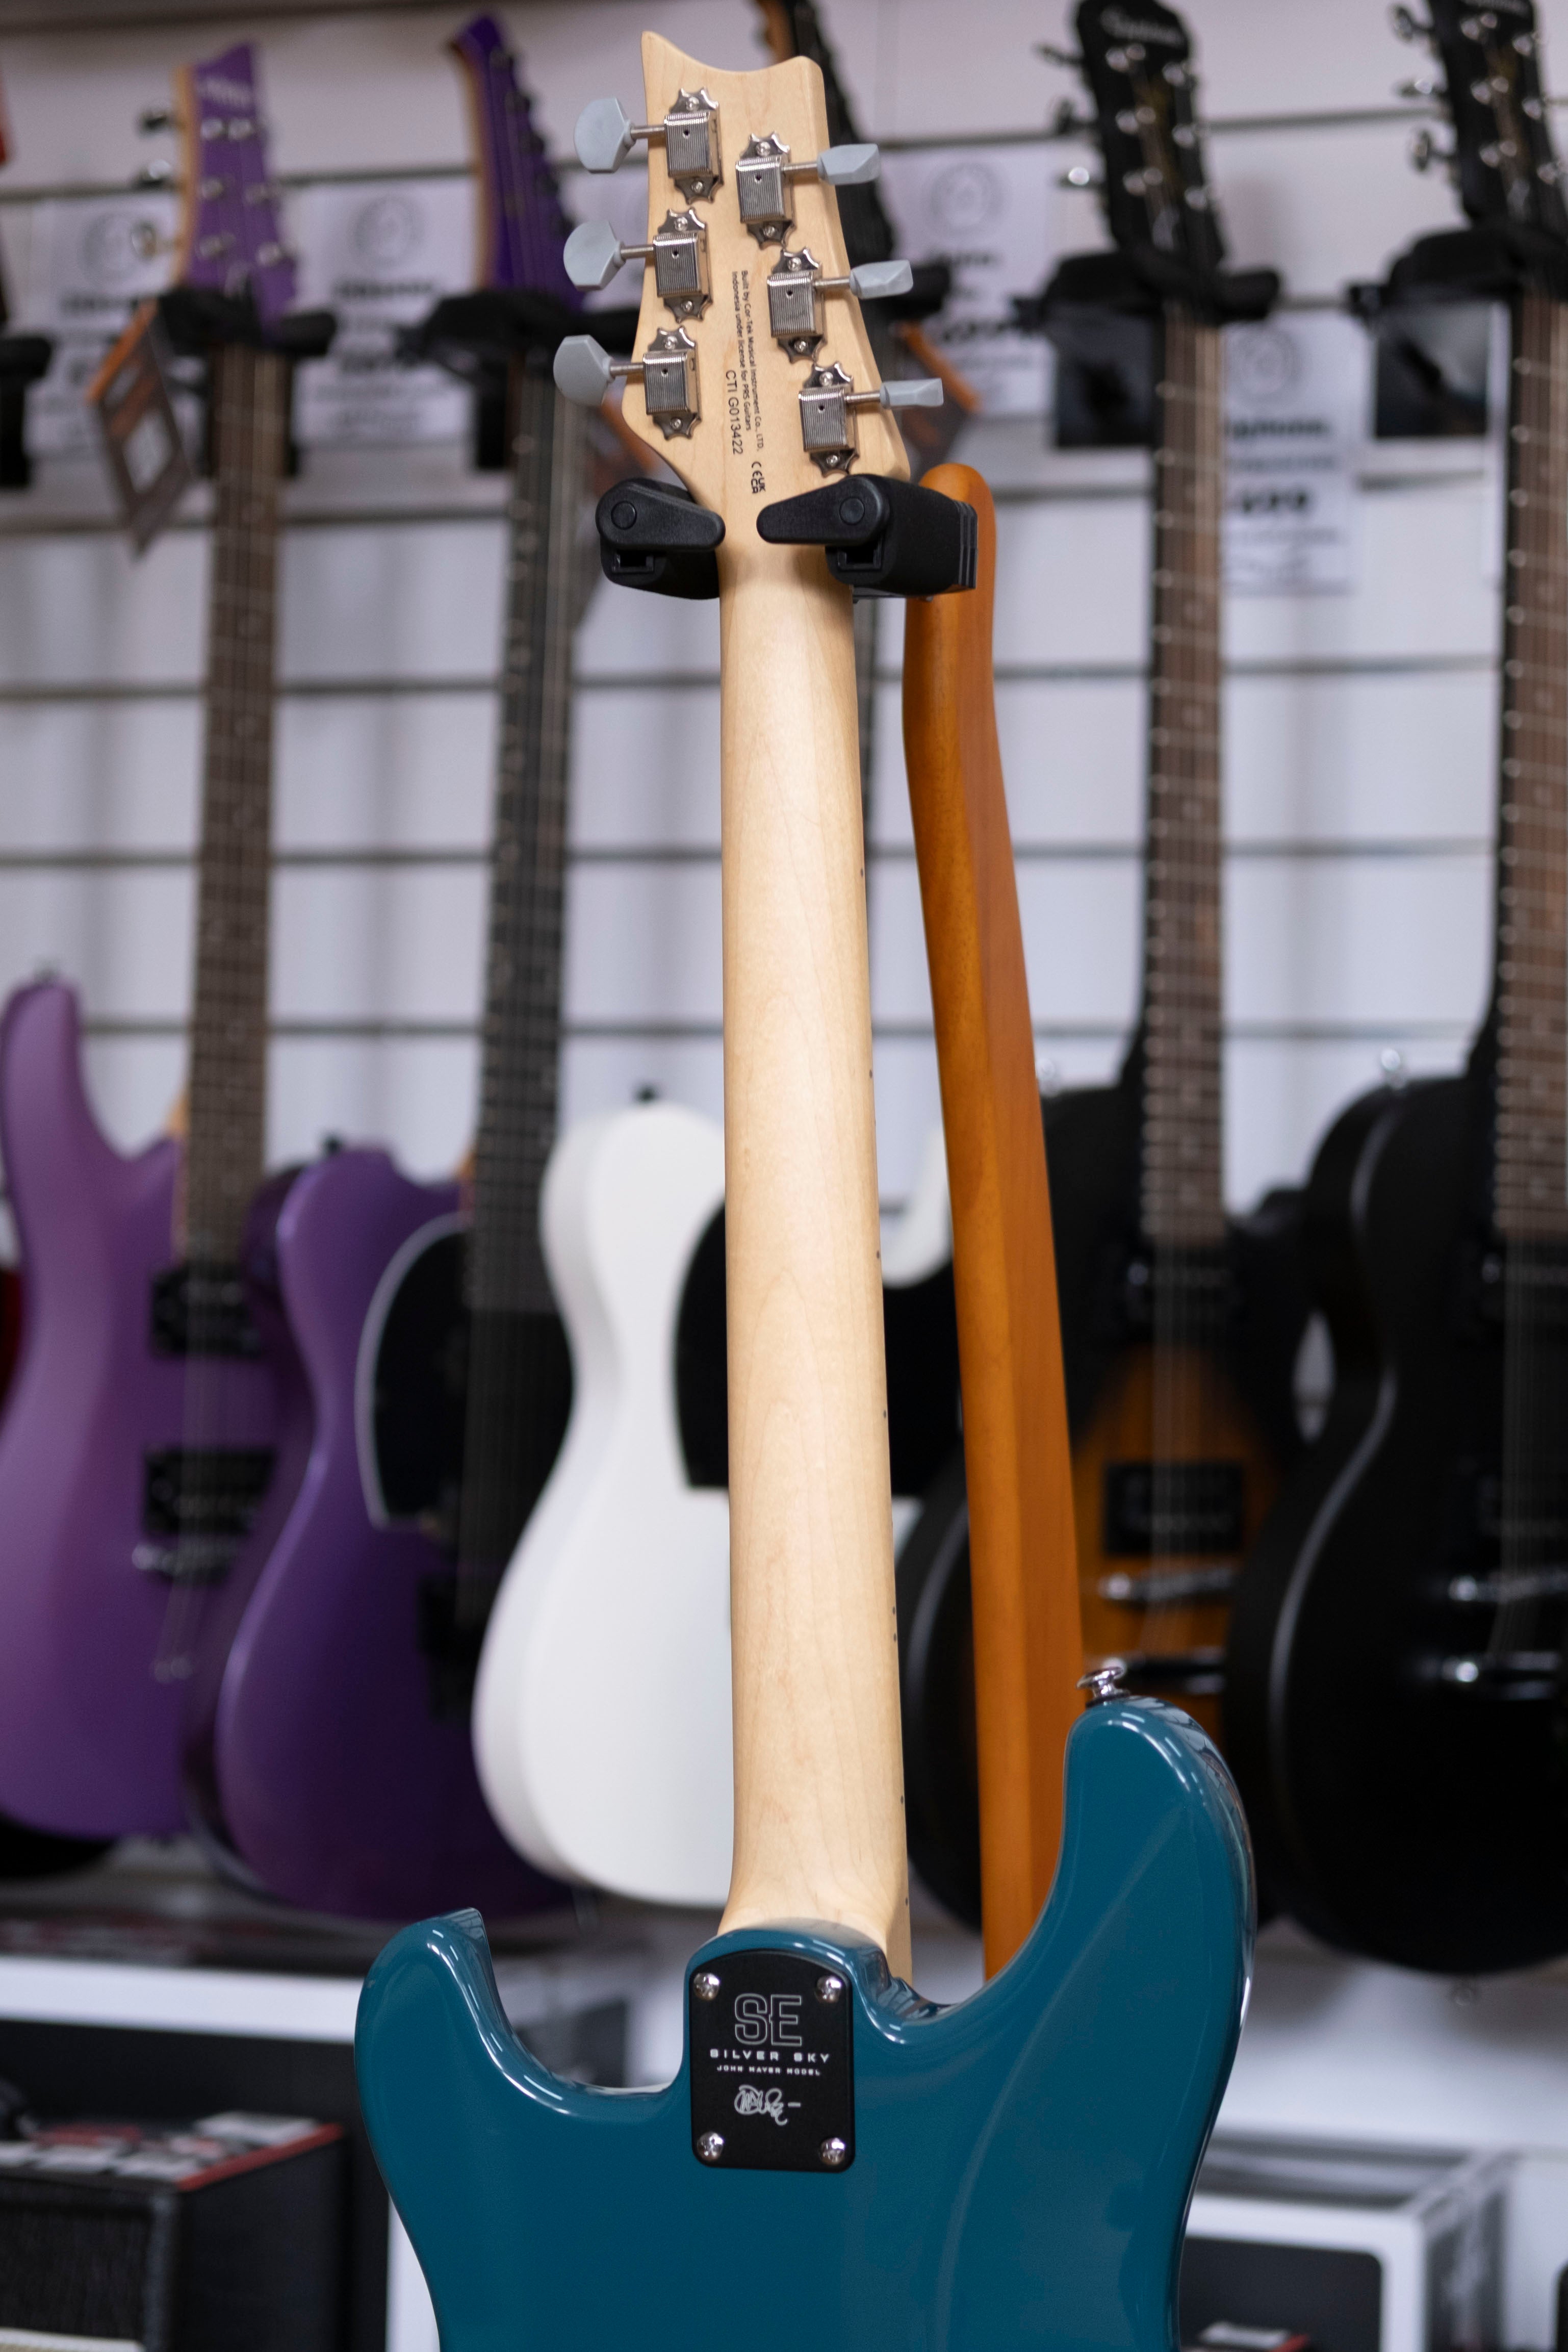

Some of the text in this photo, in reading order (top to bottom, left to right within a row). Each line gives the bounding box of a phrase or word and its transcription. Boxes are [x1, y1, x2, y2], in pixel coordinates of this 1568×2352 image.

[732, 271, 740, 311] Indonesia
[742, 291, 750, 301] by
[744, 303, 753, 334] Cor-Tek
[748, 337, 756, 367] Musical
[751, 369, 760, 414] Instrument
[728, 397, 743, 455] G013422
[735, 1993, 802, 2046] SE
[710, 2049, 830, 2063] SILVER SKY
[749, 2066, 781, 2074] MAYER
[787, 2068, 820, 2076] MODEL
